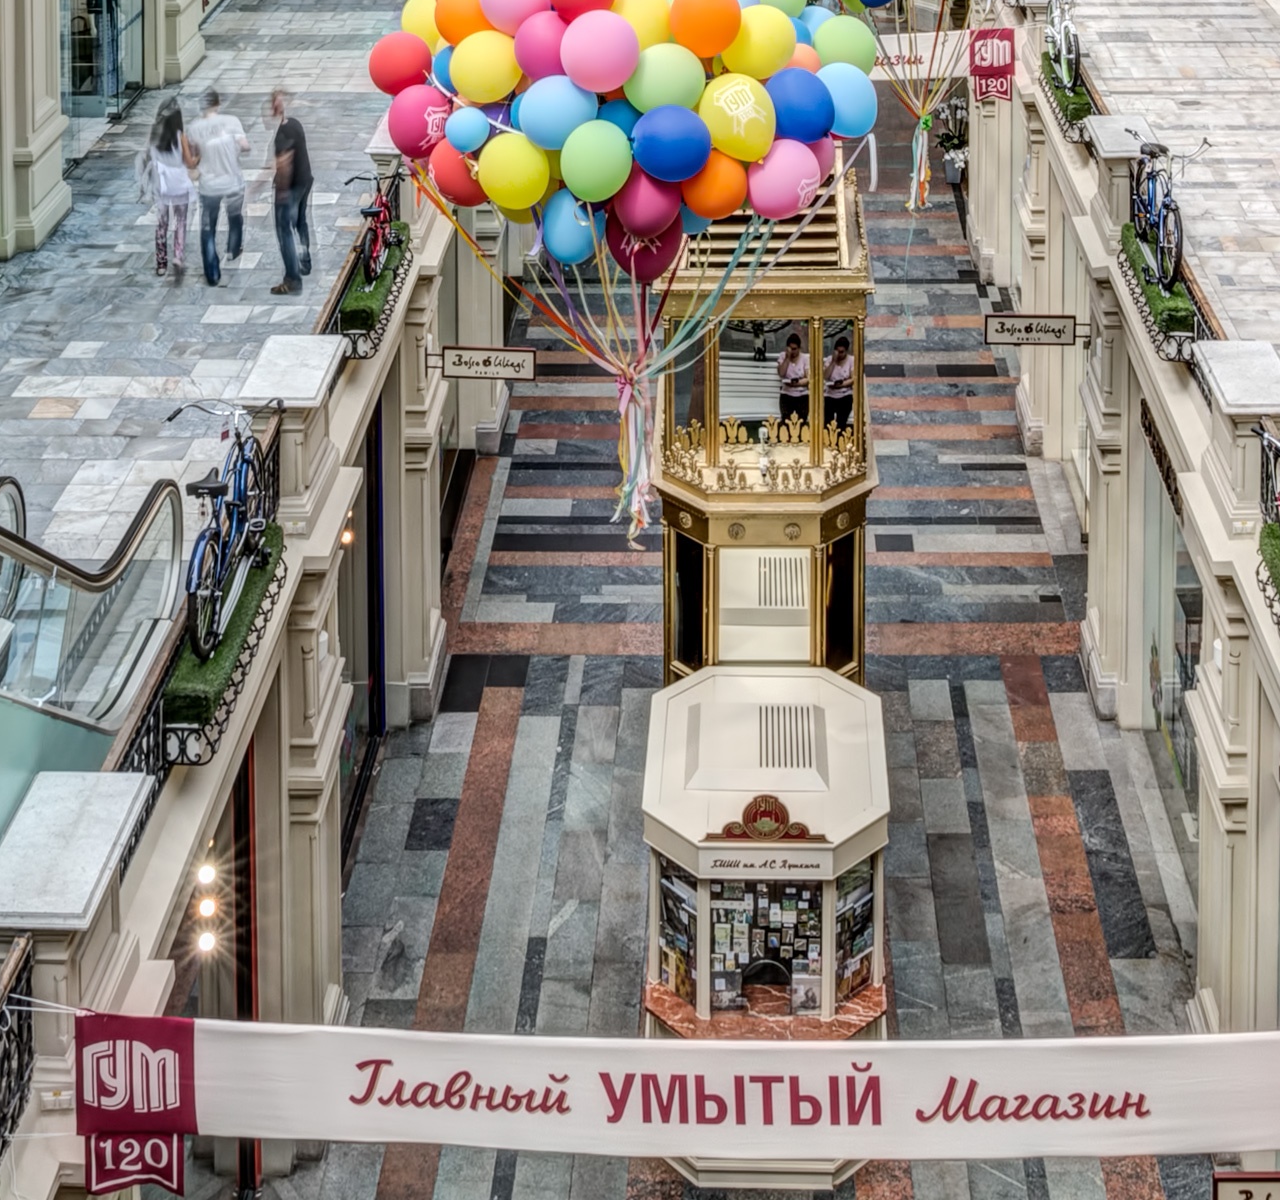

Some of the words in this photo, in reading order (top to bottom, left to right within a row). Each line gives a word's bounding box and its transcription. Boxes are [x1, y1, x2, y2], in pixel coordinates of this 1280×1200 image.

[974, 38, 1012, 69] ГУМ
[980, 76, 1008, 93] 120
[82, 1038, 181, 1114] ГУМ
[348, 1058, 572, 1115] Главный
[598, 1061, 883, 1128] УМЫТЫЙ
[915, 1073, 1152, 1126] Магазин
[98, 1135, 171, 1173] 120
